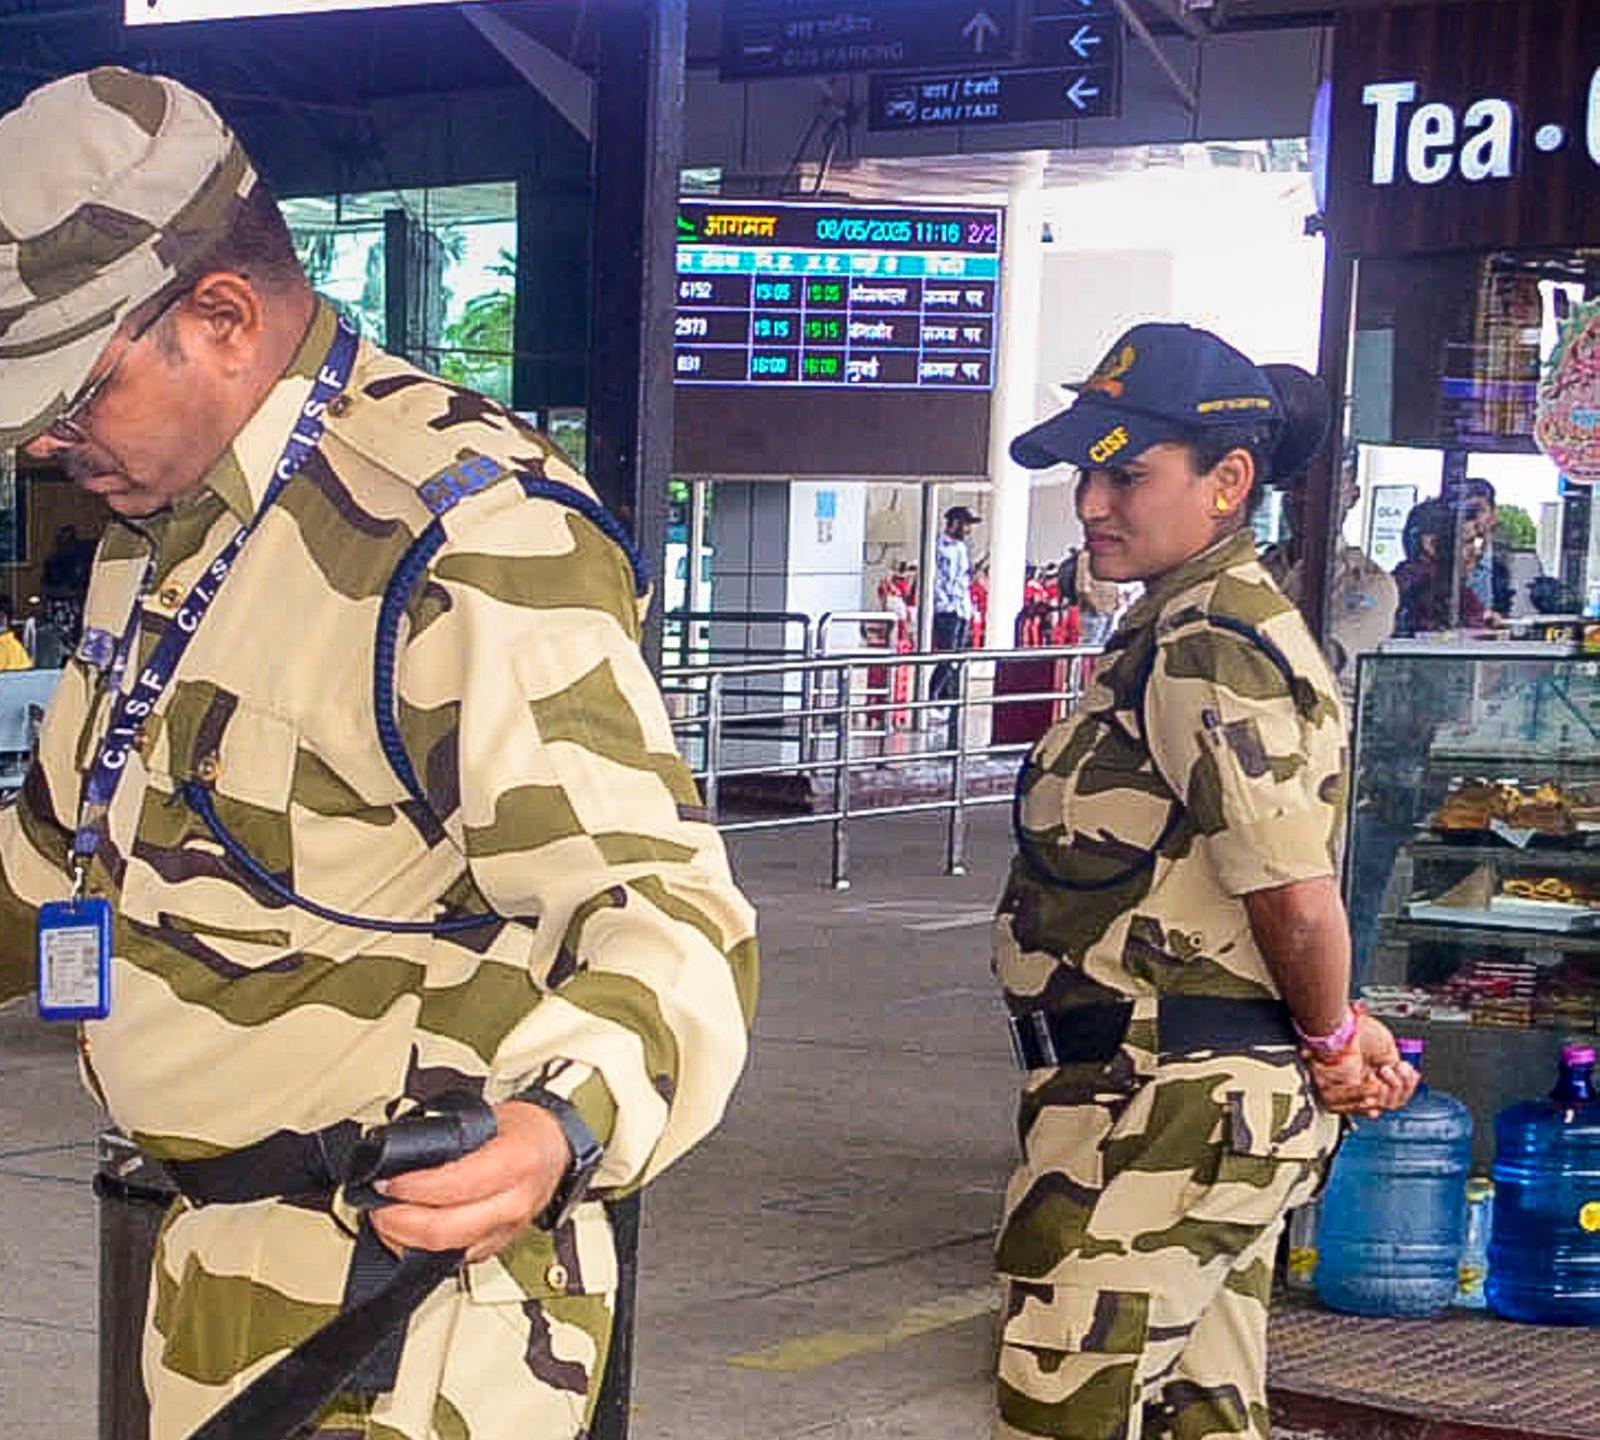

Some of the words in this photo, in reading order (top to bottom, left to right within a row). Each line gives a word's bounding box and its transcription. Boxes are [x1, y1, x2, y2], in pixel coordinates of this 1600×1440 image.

[1363, 80, 1514, 185] Tea
[704, 214, 777, 238] आगमन
[916, 222, 961, 243] 11:16
[1089, 426, 1129, 463] CISF
